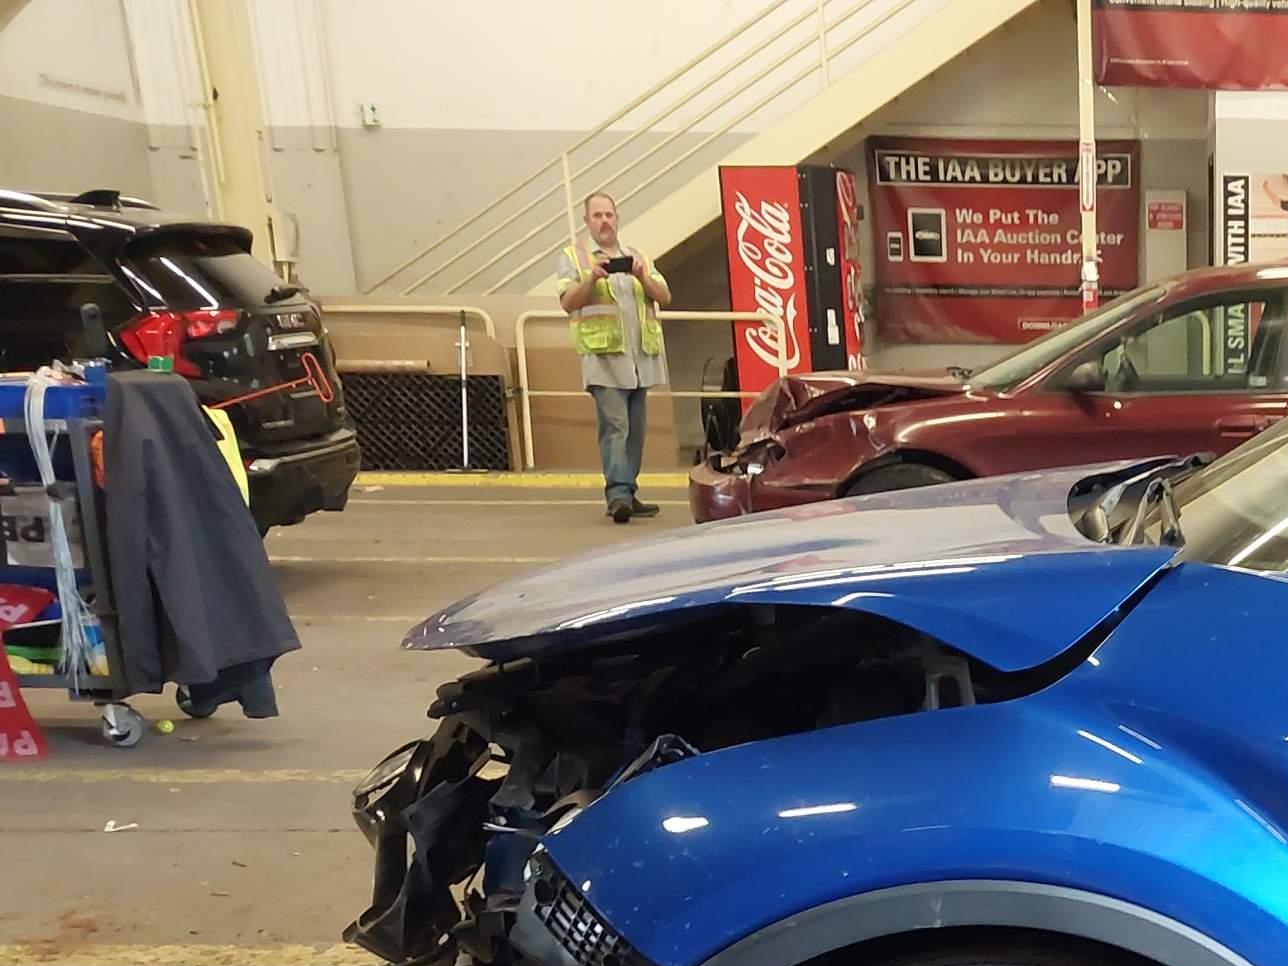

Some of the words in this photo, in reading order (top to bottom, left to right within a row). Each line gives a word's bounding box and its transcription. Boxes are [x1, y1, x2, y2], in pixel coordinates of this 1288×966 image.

[884, 156, 931, 181] THE
[938, 158, 981, 182] IAA
[988, 159, 1067, 183] BUYER
[1228, 179, 1245, 215] IAA
[955, 208, 983, 225] We
[989, 209, 1020, 225] Put
[1025, 209, 1059, 225] The
[956, 229, 990, 244] IAA
[994, 229, 1061, 245] Auction
[1066, 230, 1124, 246] Cter
[956, 248, 973, 264] In
[980, 248, 1020, 264] Your
